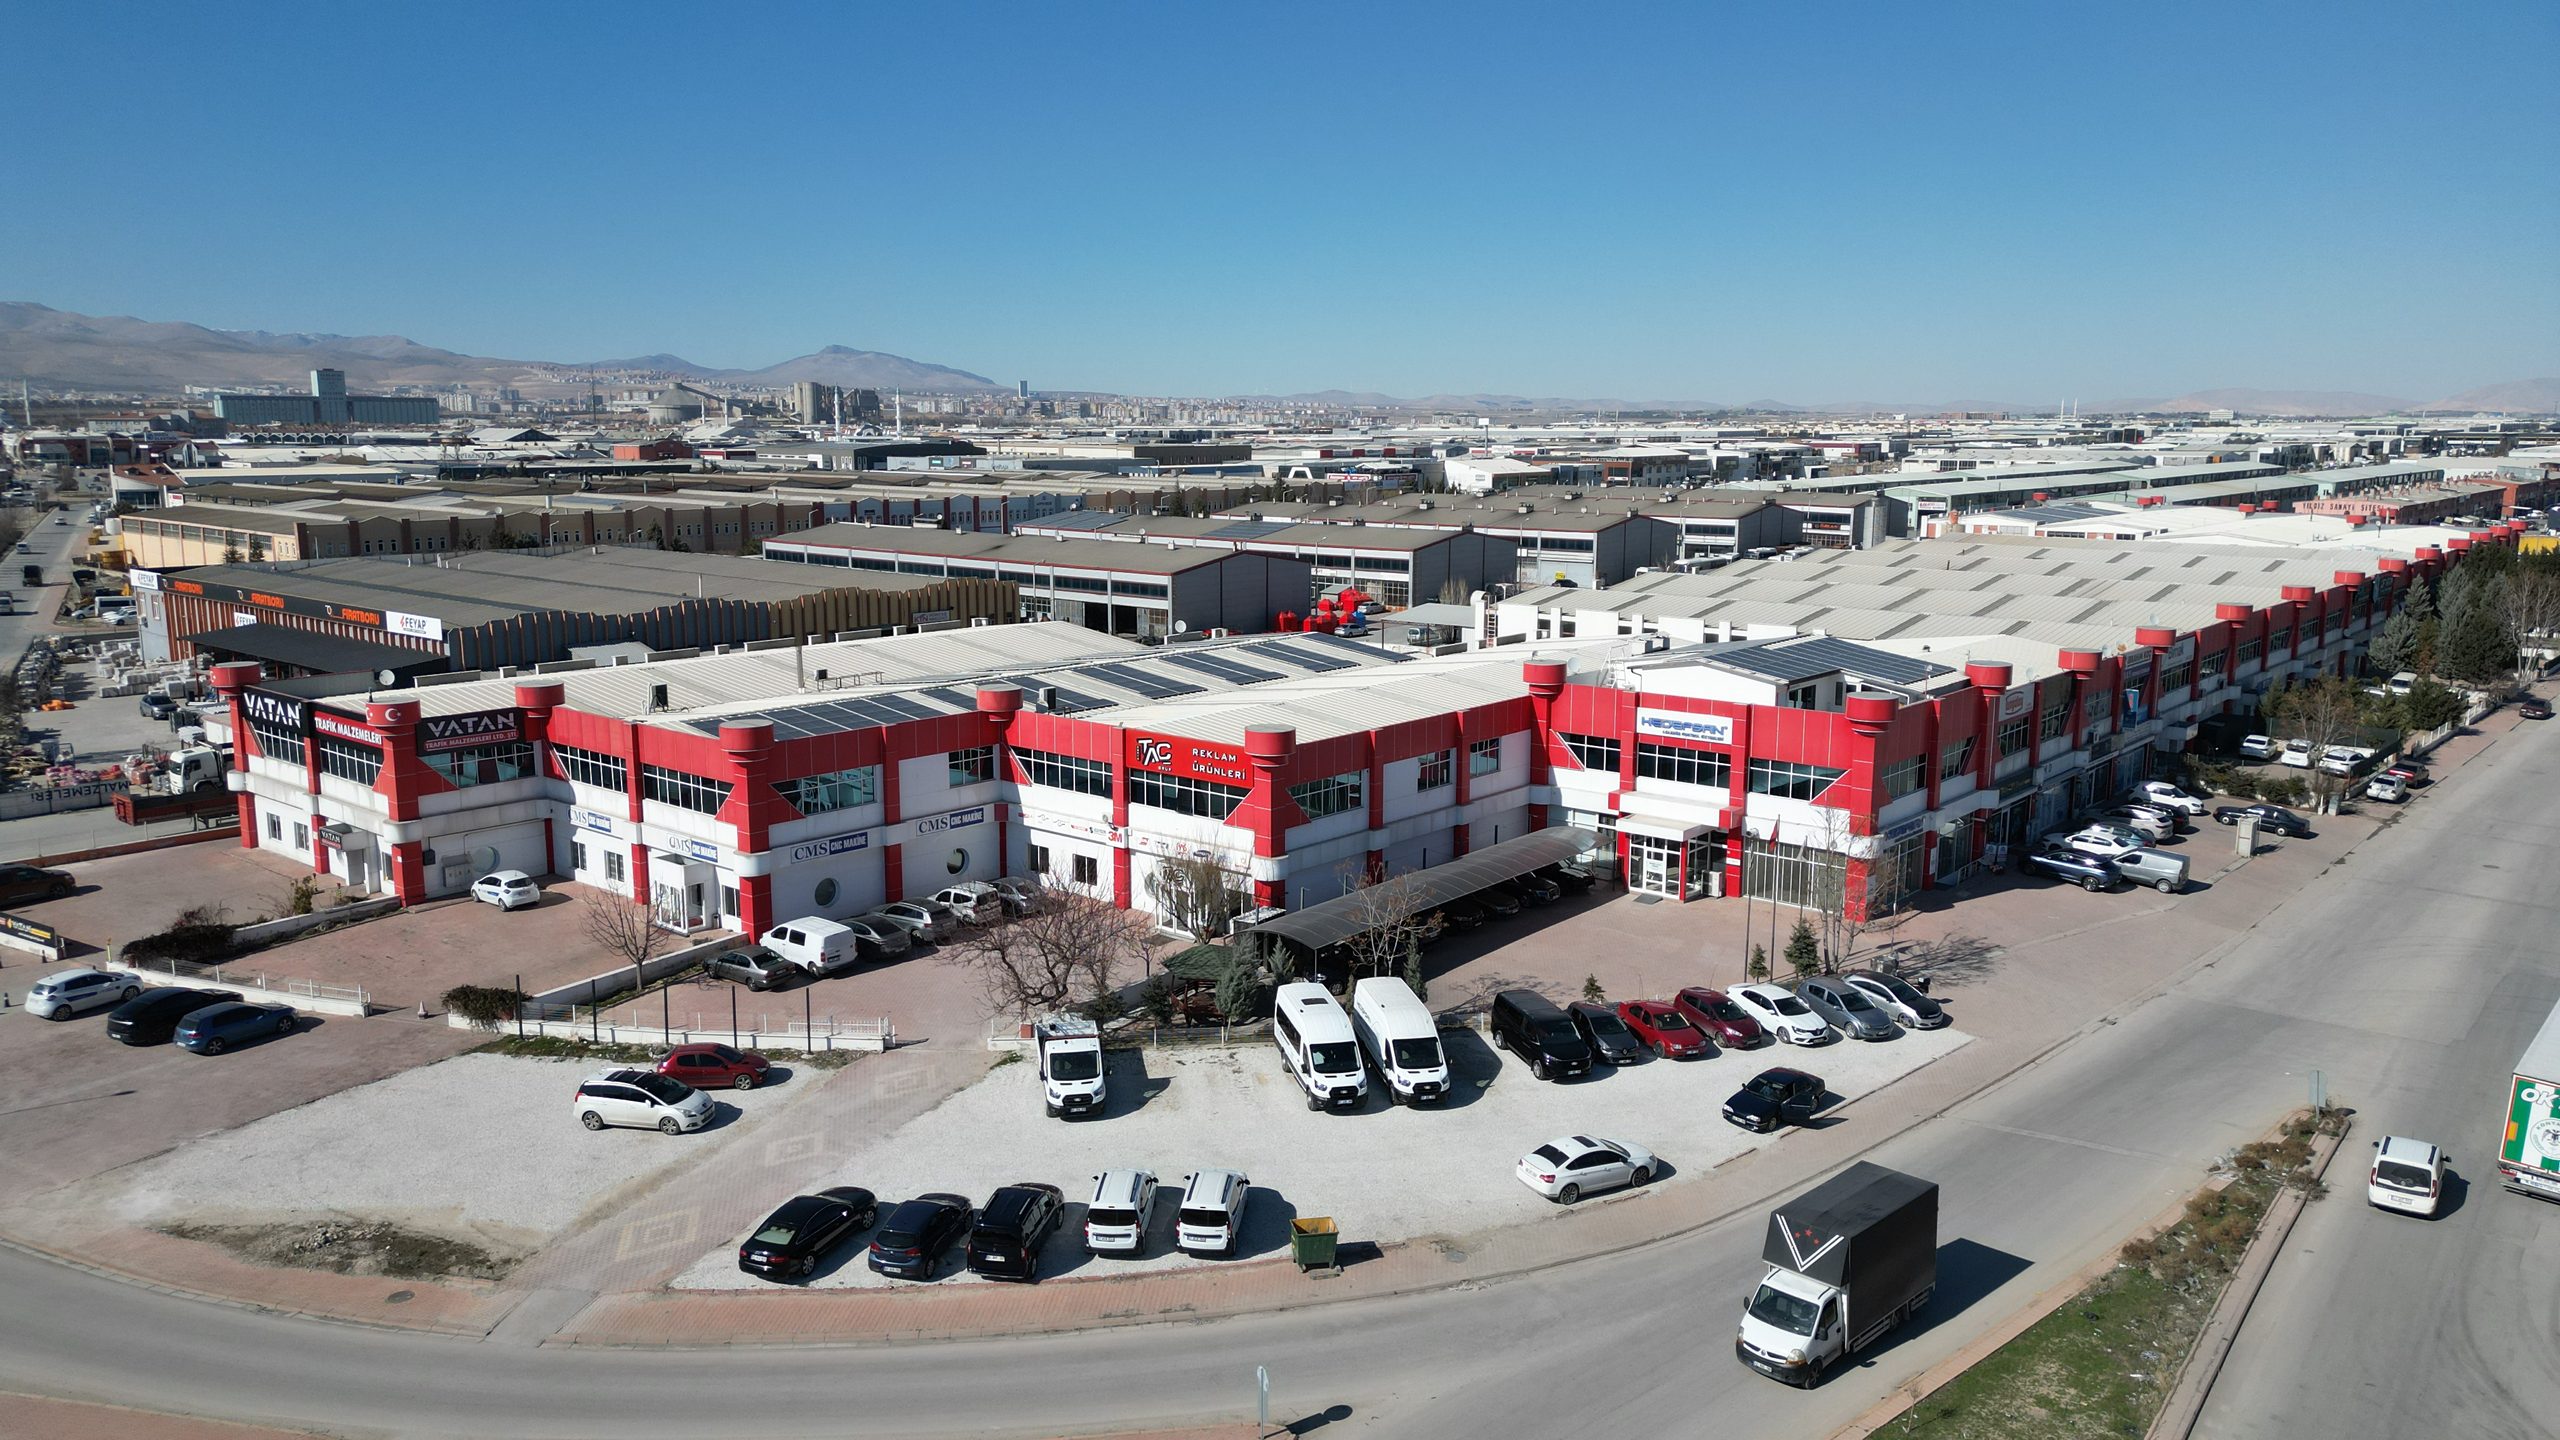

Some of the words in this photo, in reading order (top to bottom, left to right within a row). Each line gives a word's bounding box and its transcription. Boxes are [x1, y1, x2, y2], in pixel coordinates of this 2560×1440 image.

[341, 608, 380, 625] FIRATBORU
[405, 617, 427, 630] FEYAP
[243, 692, 301, 728] VATAN
[314, 716, 338, 733] TRAFİK
[427, 712, 515, 738] VATAN
[1192, 748, 1237, 762] REKLAM
[1192, 760, 1246, 780] ÜRÜNLERİ
[918, 816, 948, 834] CMS
[950, 815, 962, 825] CNC
[1108, 831, 1123, 843] 3M
[794, 842, 828, 861] CMS
[830, 840, 843, 851] CNC
